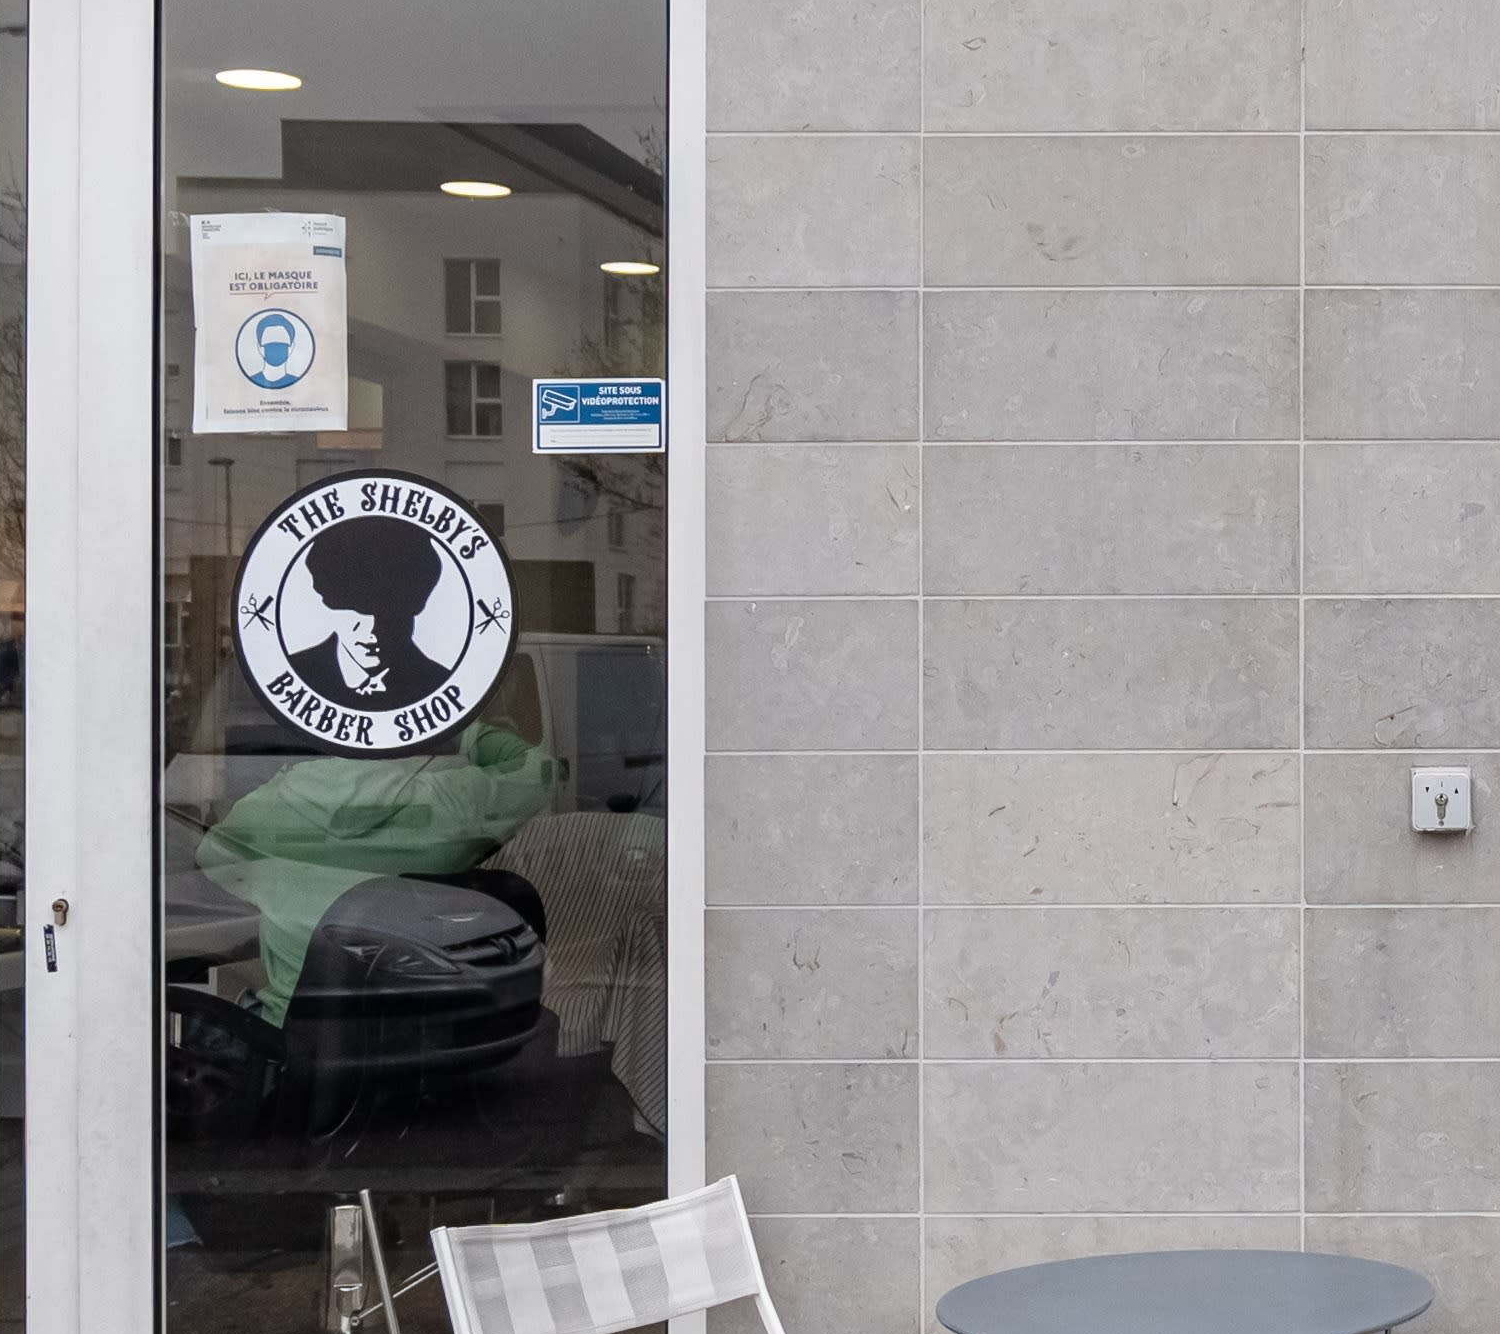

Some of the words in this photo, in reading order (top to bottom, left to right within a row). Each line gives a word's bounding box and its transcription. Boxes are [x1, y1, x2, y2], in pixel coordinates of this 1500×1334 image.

[229, 282, 245, 291] EST
[249, 281, 319, 290] OBLIGATOIRE
[254, 272, 266, 280] LE
[268, 270, 312, 281] MASQUE
[581, 395, 659, 405] VIDÉOPROTECTION
[598, 386, 618, 395] SITE
[619, 386, 642, 395] SOUS
[278, 488, 345, 543] THE
[360, 481, 489, 560] SHELBY'S
[266, 670, 374, 745] BARBER
[394, 684, 466, 743] SHOP
